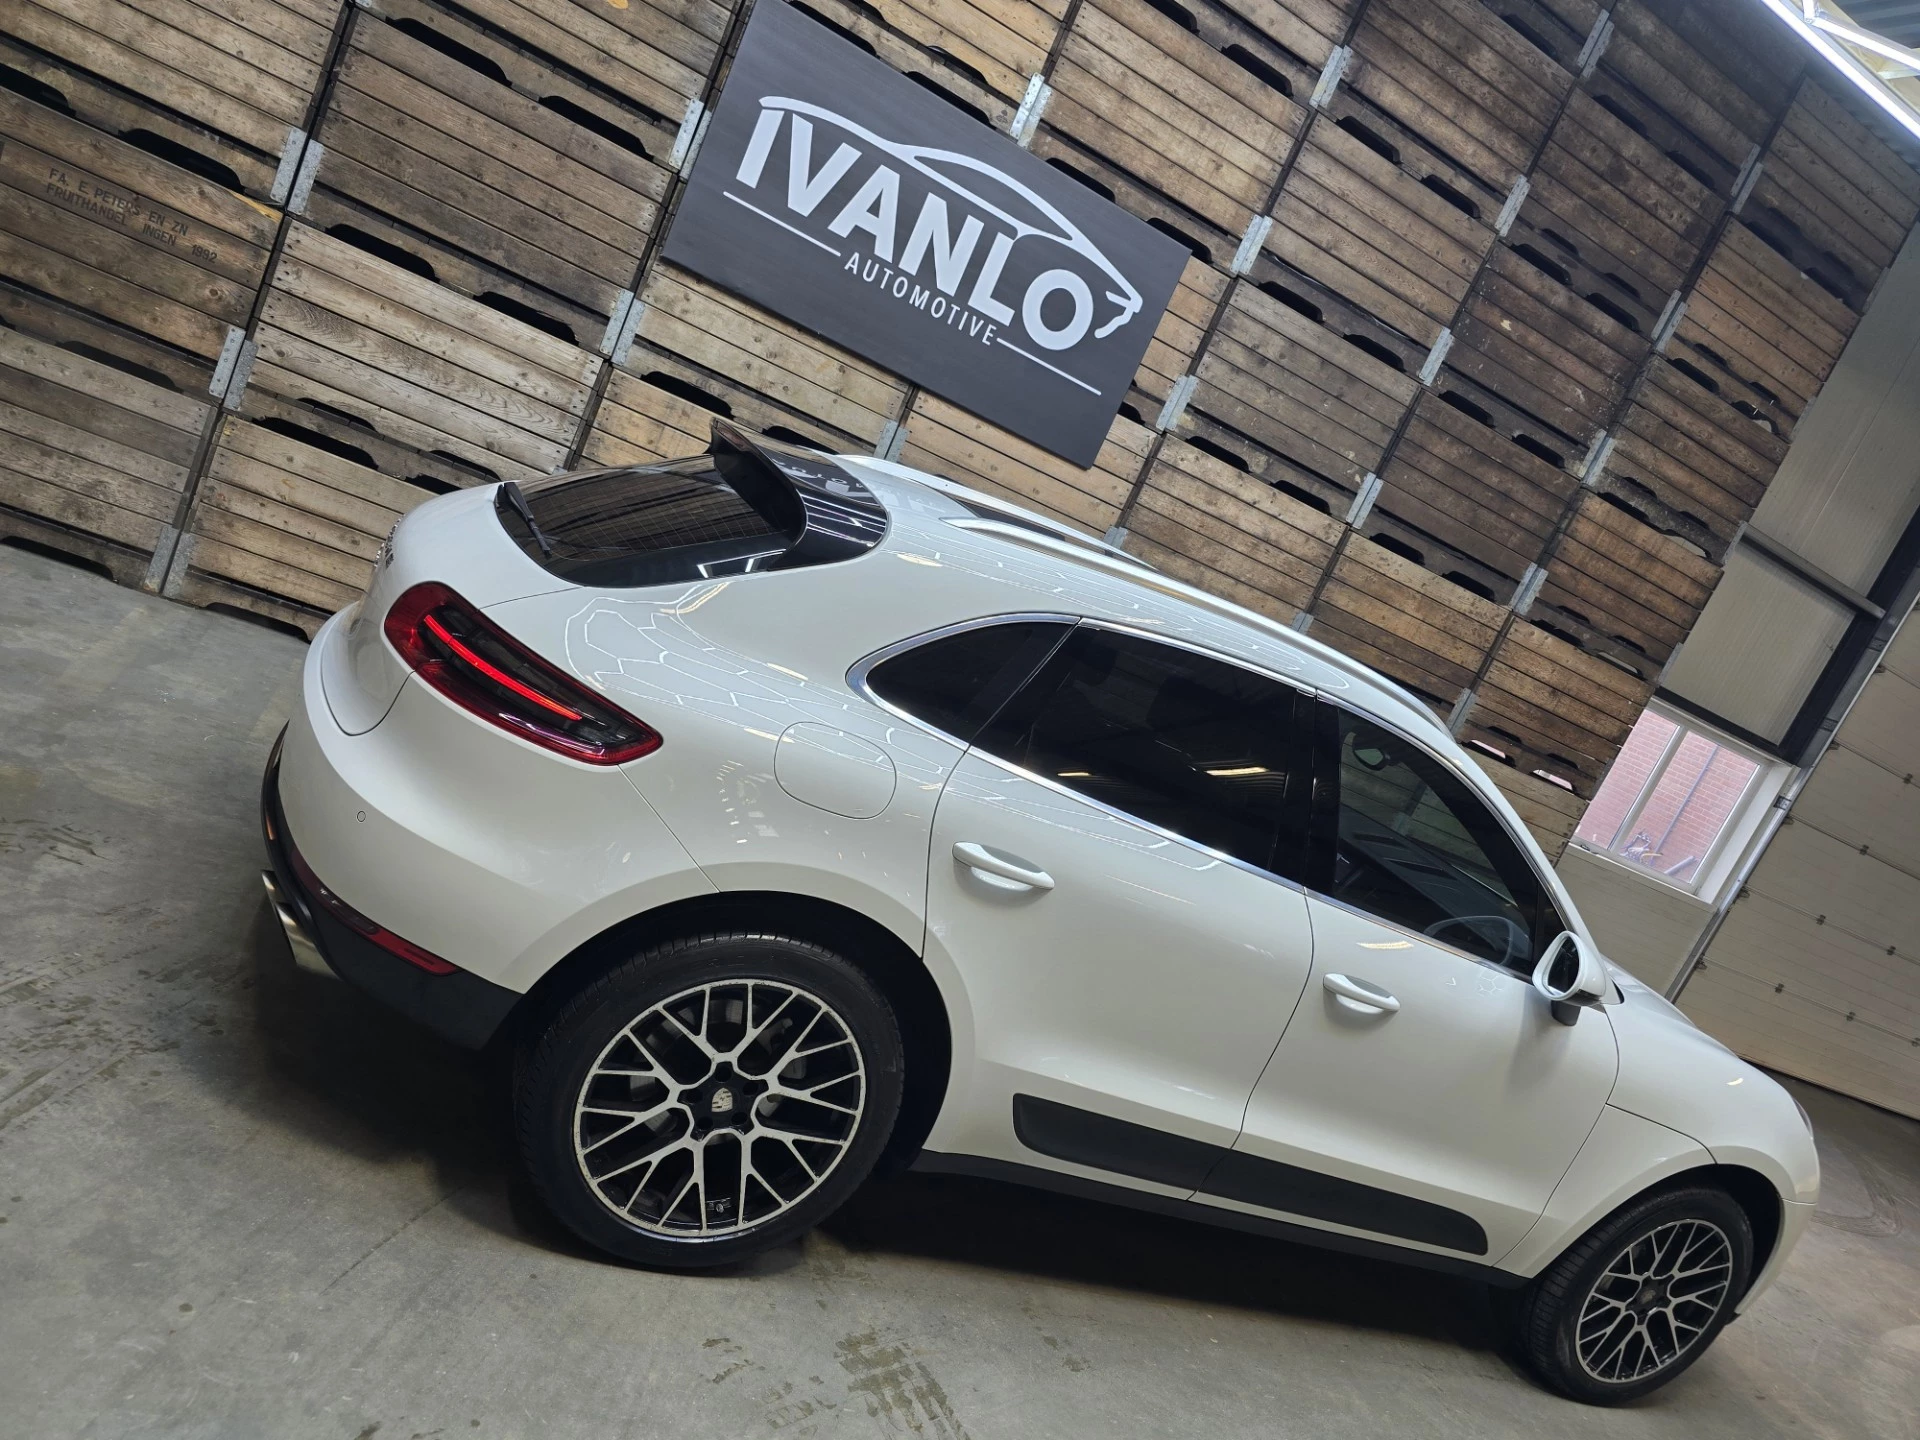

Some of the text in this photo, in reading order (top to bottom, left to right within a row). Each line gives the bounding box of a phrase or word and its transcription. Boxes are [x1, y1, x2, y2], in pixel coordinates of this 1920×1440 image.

[46, 182, 218, 264] FRUITHANDEL INGEN 1992
[49, 168, 69, 186] FA.
[94, 187, 141, 216] PETERS
[148, 211, 165, 227] EN
[171, 221, 189, 237] ZN
[736, 110, 1094, 351] IVANLO
[844, 252, 998, 346] AUTOMOTIVE
